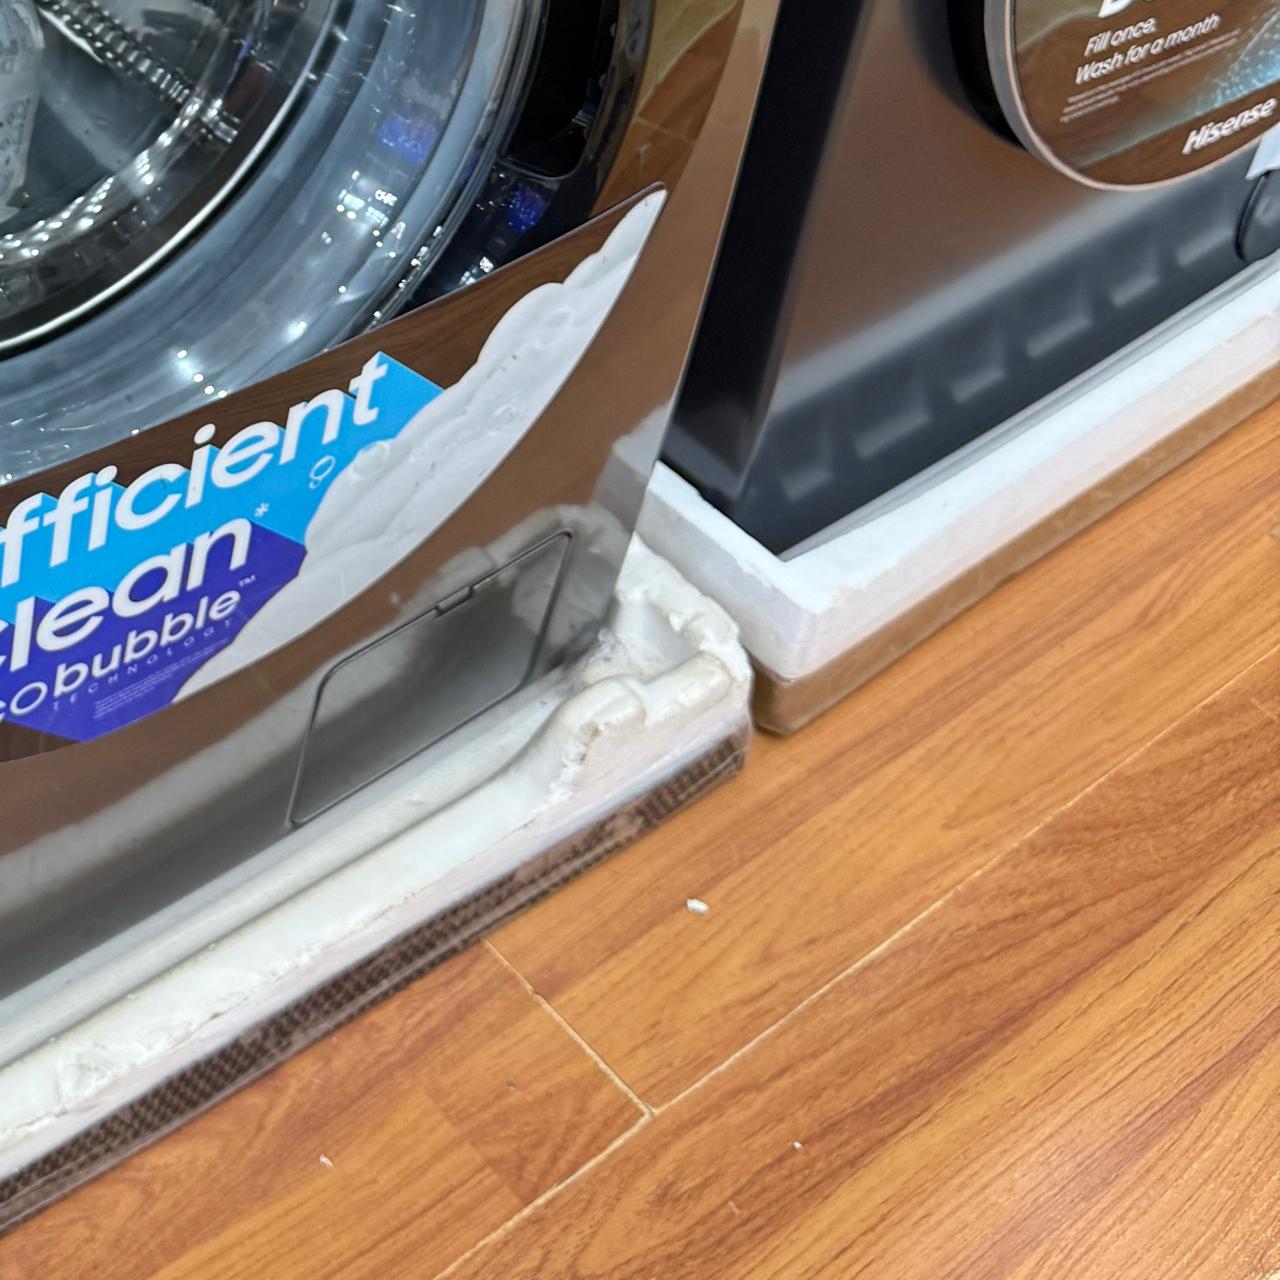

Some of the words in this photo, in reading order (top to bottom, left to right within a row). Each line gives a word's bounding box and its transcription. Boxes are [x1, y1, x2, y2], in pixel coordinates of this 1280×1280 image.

[1075, 52, 1123, 85] Wash
[1124, 43, 1150, 66] for
[1150, 37, 1165, 55] a
[1164, 13, 1221, 49] month
[1084, 30, 1111, 57] Fill
[1182, 97, 1278, 155] Hisense
